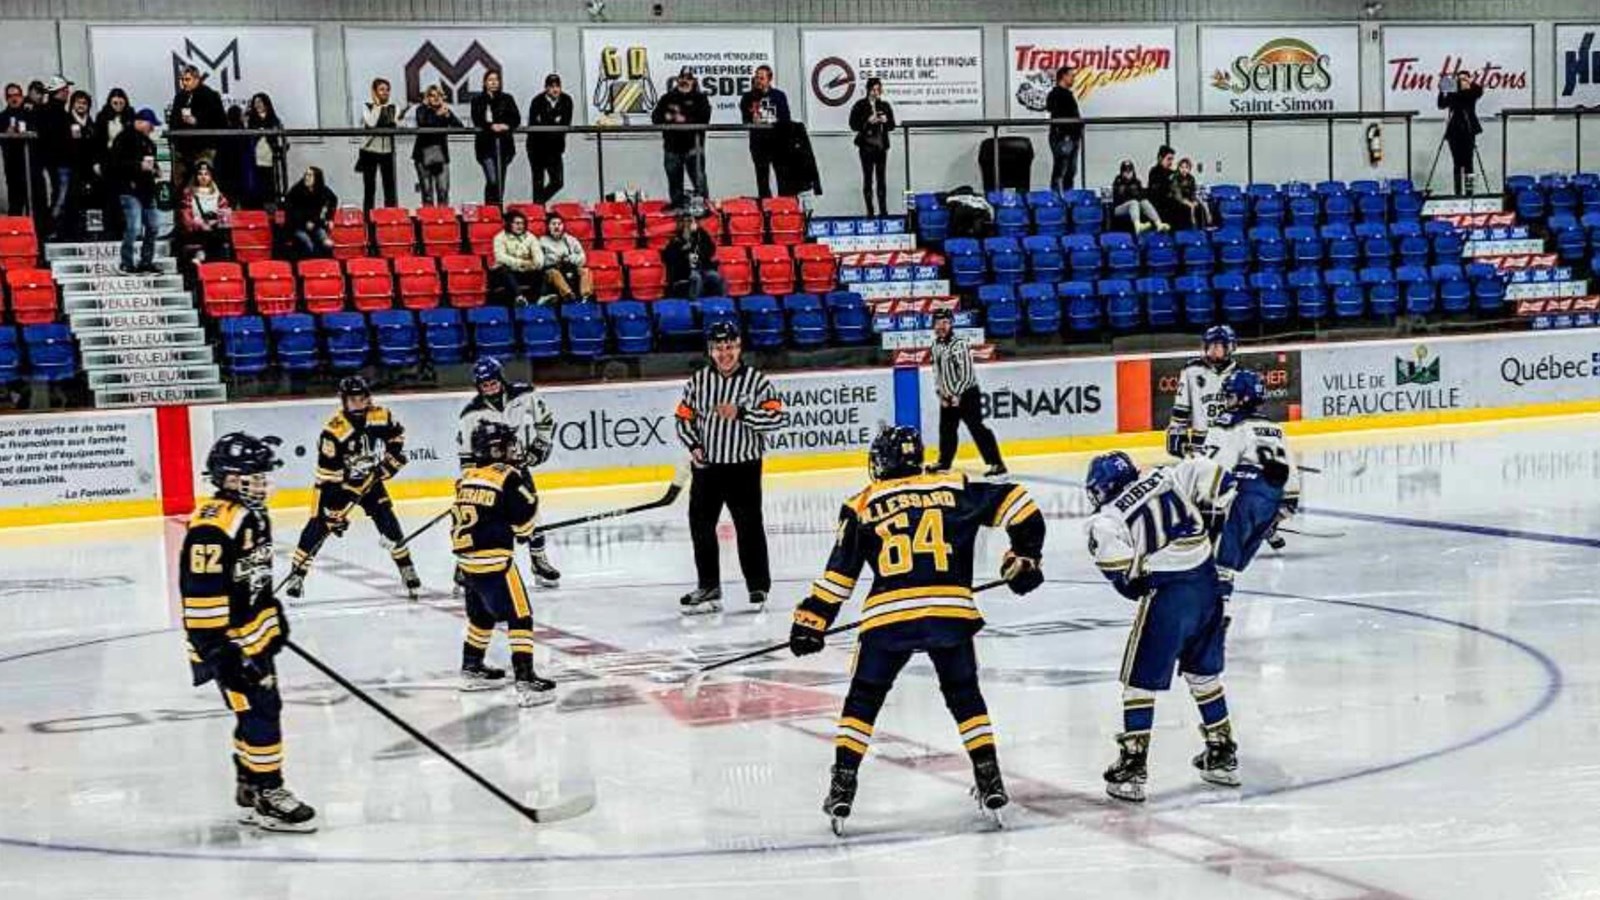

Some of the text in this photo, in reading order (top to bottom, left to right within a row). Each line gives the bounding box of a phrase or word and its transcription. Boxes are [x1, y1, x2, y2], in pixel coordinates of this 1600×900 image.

[859, 58, 871, 68] LE
[873, 57, 913, 68] CENTRE
[1015, 44, 1171, 71] Transmission
[1231, 54, 1332, 93] Serres
[1388, 55, 1526, 91] Tim Hrtons
[1230, 96, 1334, 113] Saint-Simon
[1322, 372, 1385, 392] VILLE DE
[1500, 353, 1588, 387] Québec
[767, 384, 877, 408] INANCIÈRE
[1322, 388, 1462, 417] BEAUCEVILLE
[782, 407, 860, 429] BANQUE
[761, 427, 870, 452] NATIONALE
[80, 486, 131, 499] Fondation
[1114, 469, 1164, 513] ROBERT
[1125, 489, 1202, 554] 74
[874, 508, 953, 578] 64
[190, 543, 224, 574] 62
